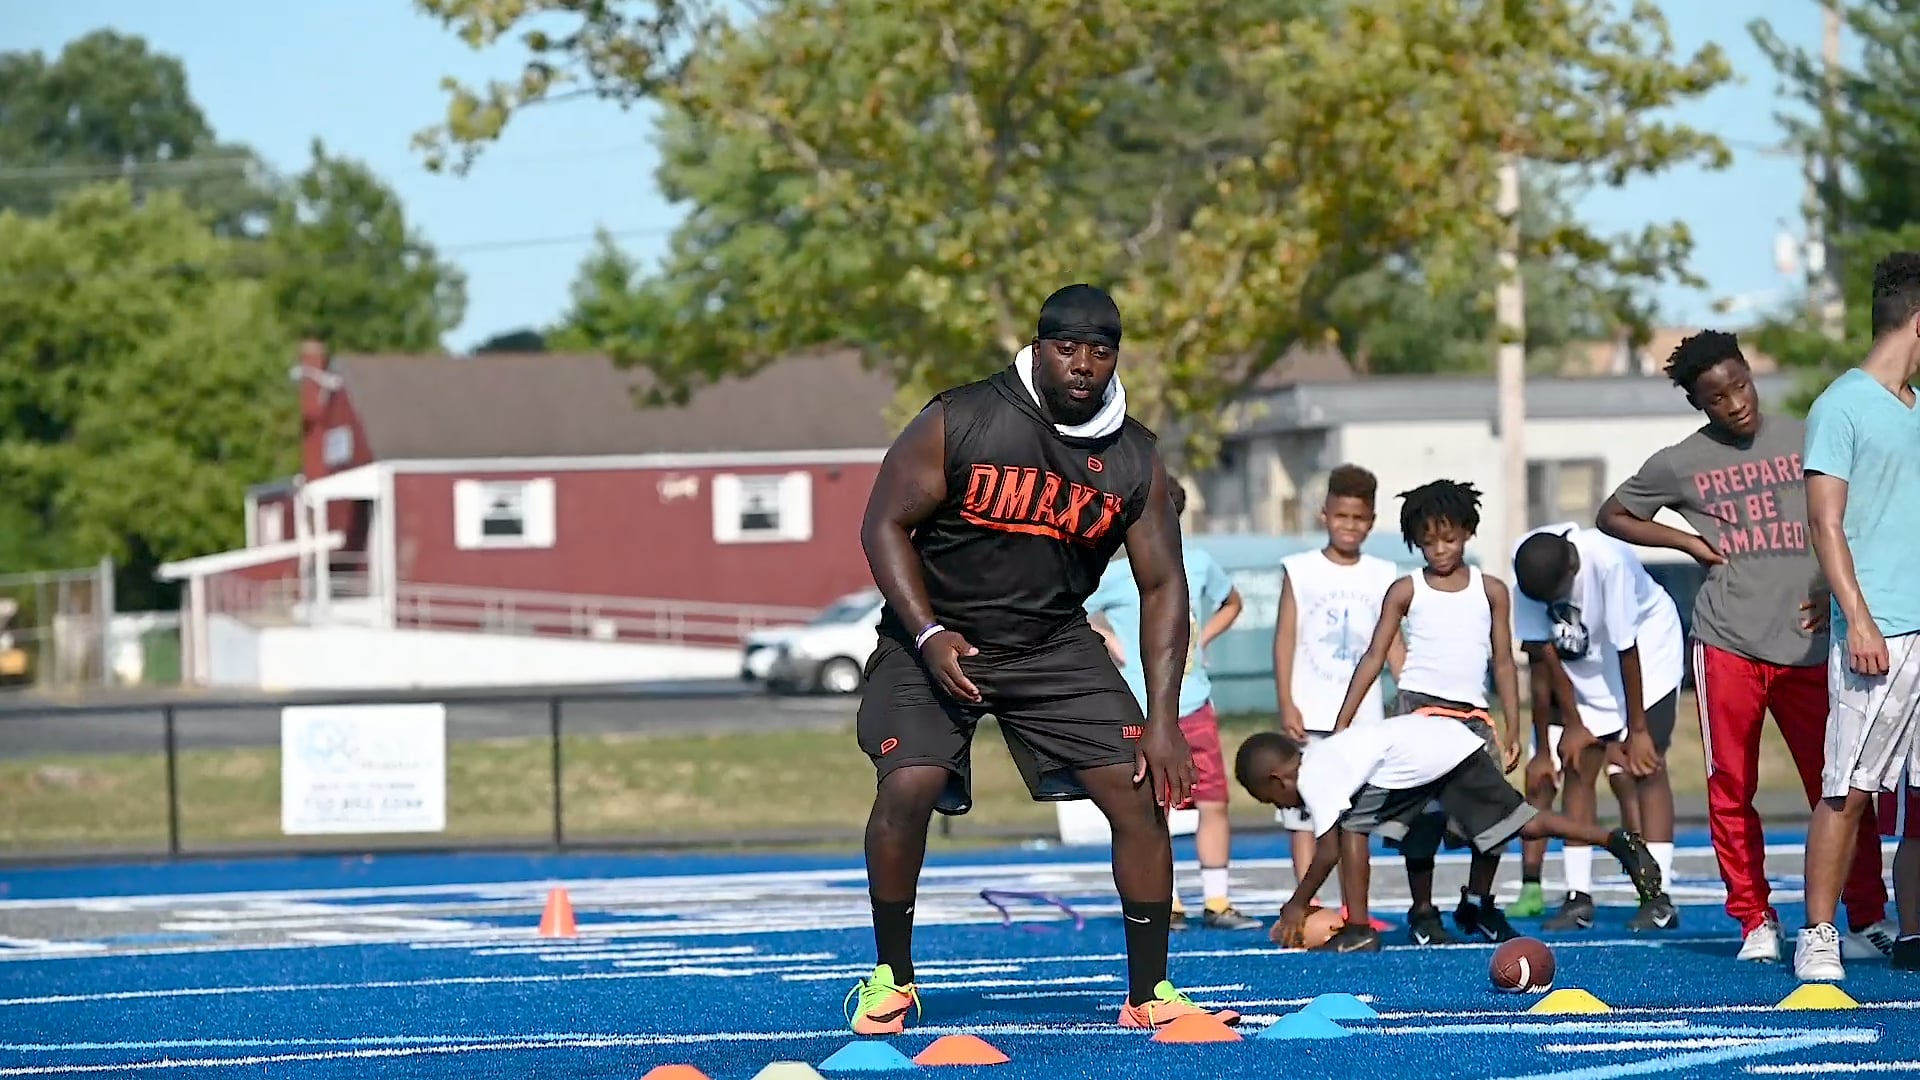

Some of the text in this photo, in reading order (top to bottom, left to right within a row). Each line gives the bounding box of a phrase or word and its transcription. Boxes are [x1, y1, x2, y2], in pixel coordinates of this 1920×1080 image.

[1694, 453, 1804, 500] PREPARE
[1704, 490, 1778, 528] TO BE
[1718, 521, 1805, 557] AMAZED
[1122, 725, 1144, 736] DMA
[1866, 931, 1894, 956] NIK
